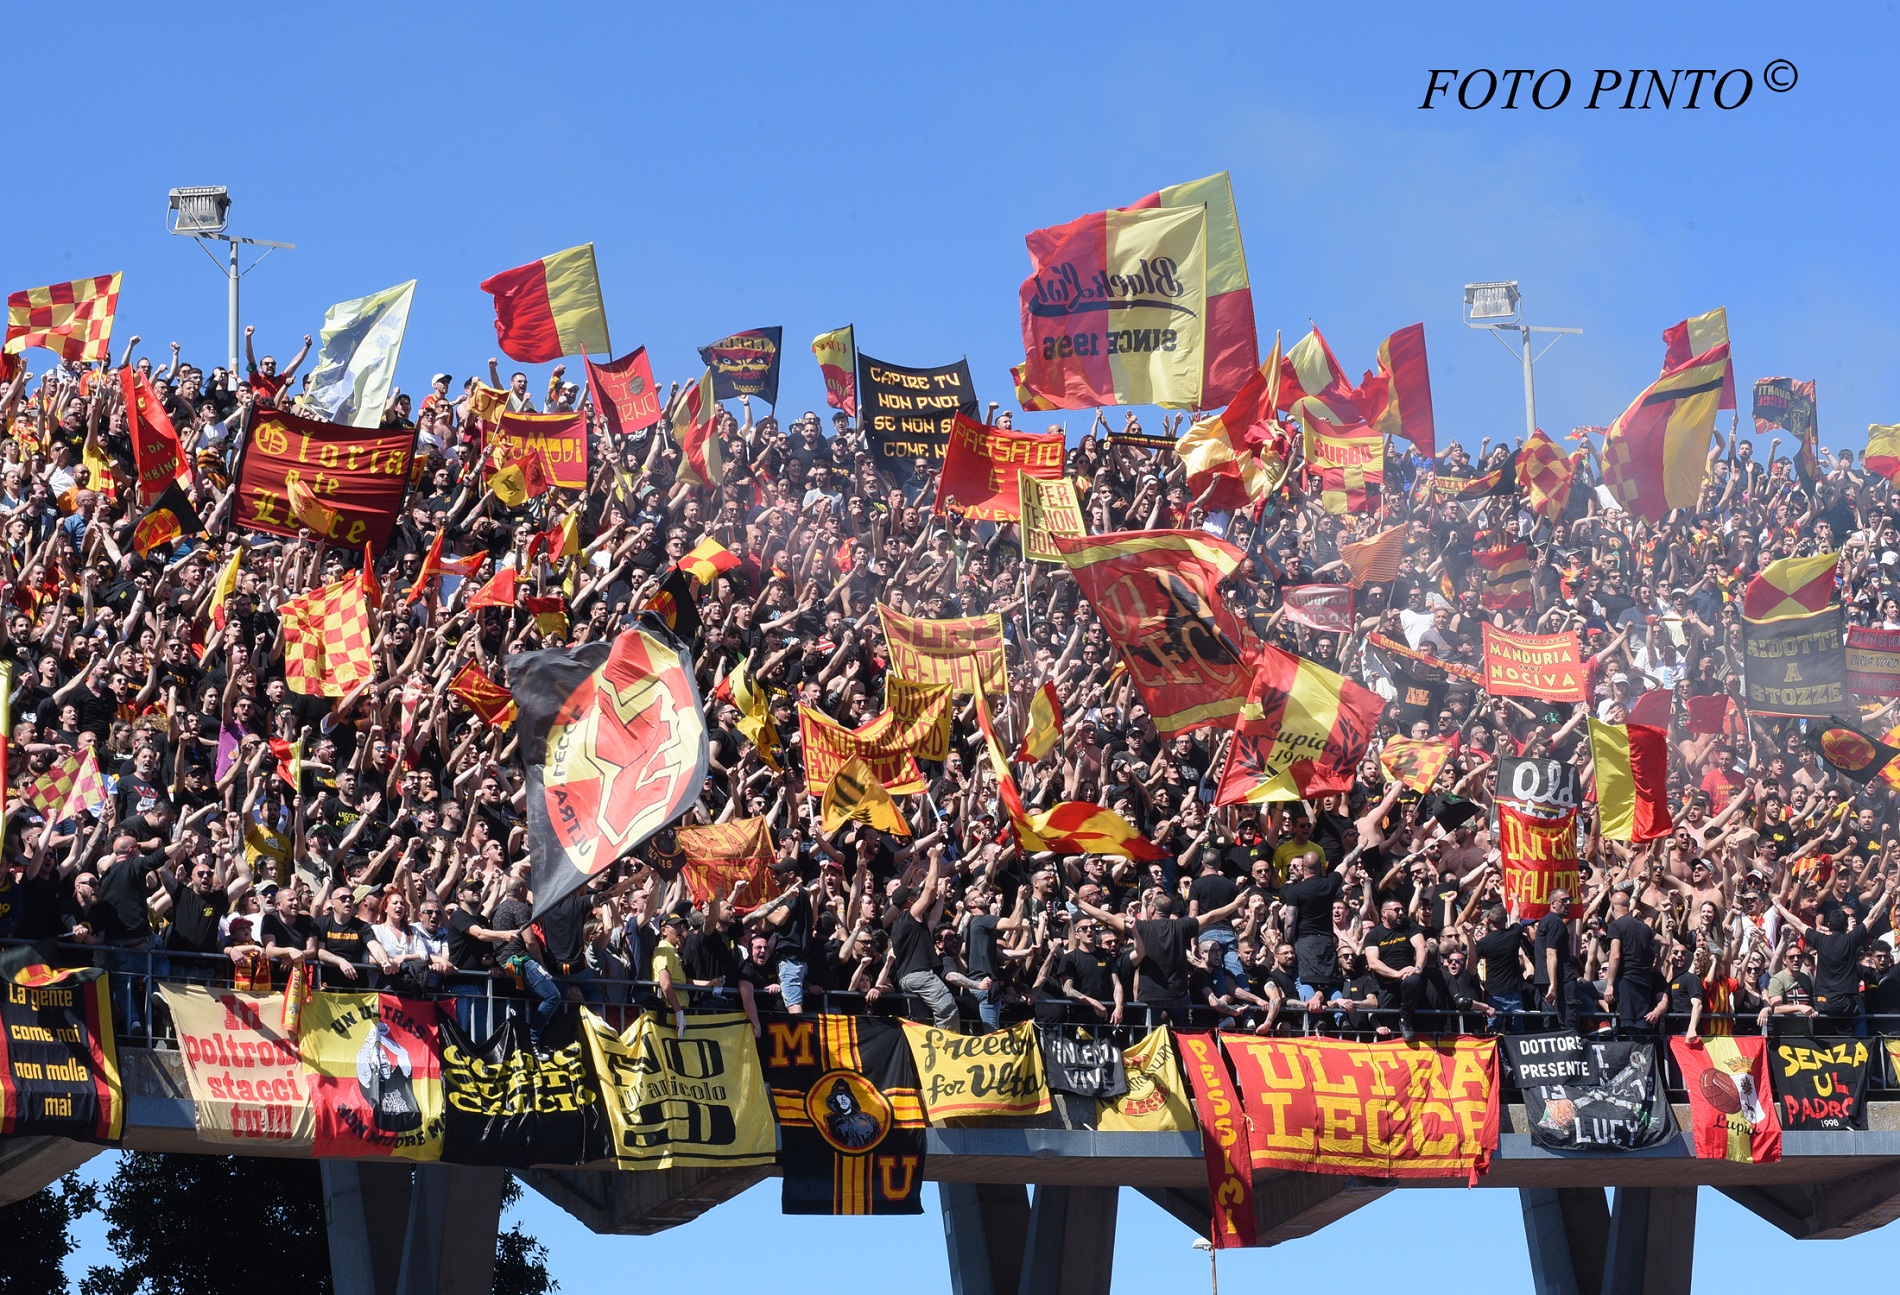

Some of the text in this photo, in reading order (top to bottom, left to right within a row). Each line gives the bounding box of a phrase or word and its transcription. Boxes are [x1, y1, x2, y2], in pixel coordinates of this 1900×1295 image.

[870, 367, 930, 390] CAPIRE
[878, 393, 913, 410] NON
[874, 416, 896, 432] SE
[901, 418, 935, 434] NON
[255, 419, 407, 475] Gloria
[884, 442, 929, 458] COME
[954, 421, 1062, 467] PASSATO
[1314, 439, 1373, 465] SURBO
[313, 471, 340, 495] te
[1036, 484, 1071, 507] PER
[252, 487, 367, 544] Lece
[1024, 503, 1078, 531] TE NON
[1380, 637, 1425, 660] MANDURIA
[1490, 641, 1572, 665] MANDURIA
[1747, 628, 1840, 658] RIDOTTI
[1491, 664, 1576, 687] NOCIVA
[1783, 662, 1803, 683] A
[1875, 657, 1899, 669] NORD
[1751, 682, 1843, 705] STOZZE
[1260, 722, 1341, 755] Lupiae
[1513, 760, 1577, 808] Old
[8, 983, 72, 1012] La gente
[220, 995, 263, 1030] In
[331, 1004, 427, 1039] UN ULTRAS
[11, 1024, 80, 1043] come noi
[768, 1021, 815, 1068] M
[1519, 1036, 1584, 1056] DOTTORE
[14, 1057, 88, 1082] non molla
[1520, 1061, 1590, 1079] PRESENTE
[1778, 1041, 1869, 1077] SENZA
[207, 1070, 303, 1101] stacci
[927, 1074, 966, 1106] for
[1125, 1083, 1169, 1115] LECCE
[44, 1093, 72, 1117] mai
[231, 1102, 292, 1139] tu!!!
[337, 1103, 426, 1148] NON MUORE
[1262, 1092, 1488, 1156] LECCE
[1574, 1116, 1638, 1146] LUCY
[1821, 1119, 1839, 1128] 1998
[1187, 1039, 1245, 1234] PESSIMI
[878, 1155, 918, 1200] U
